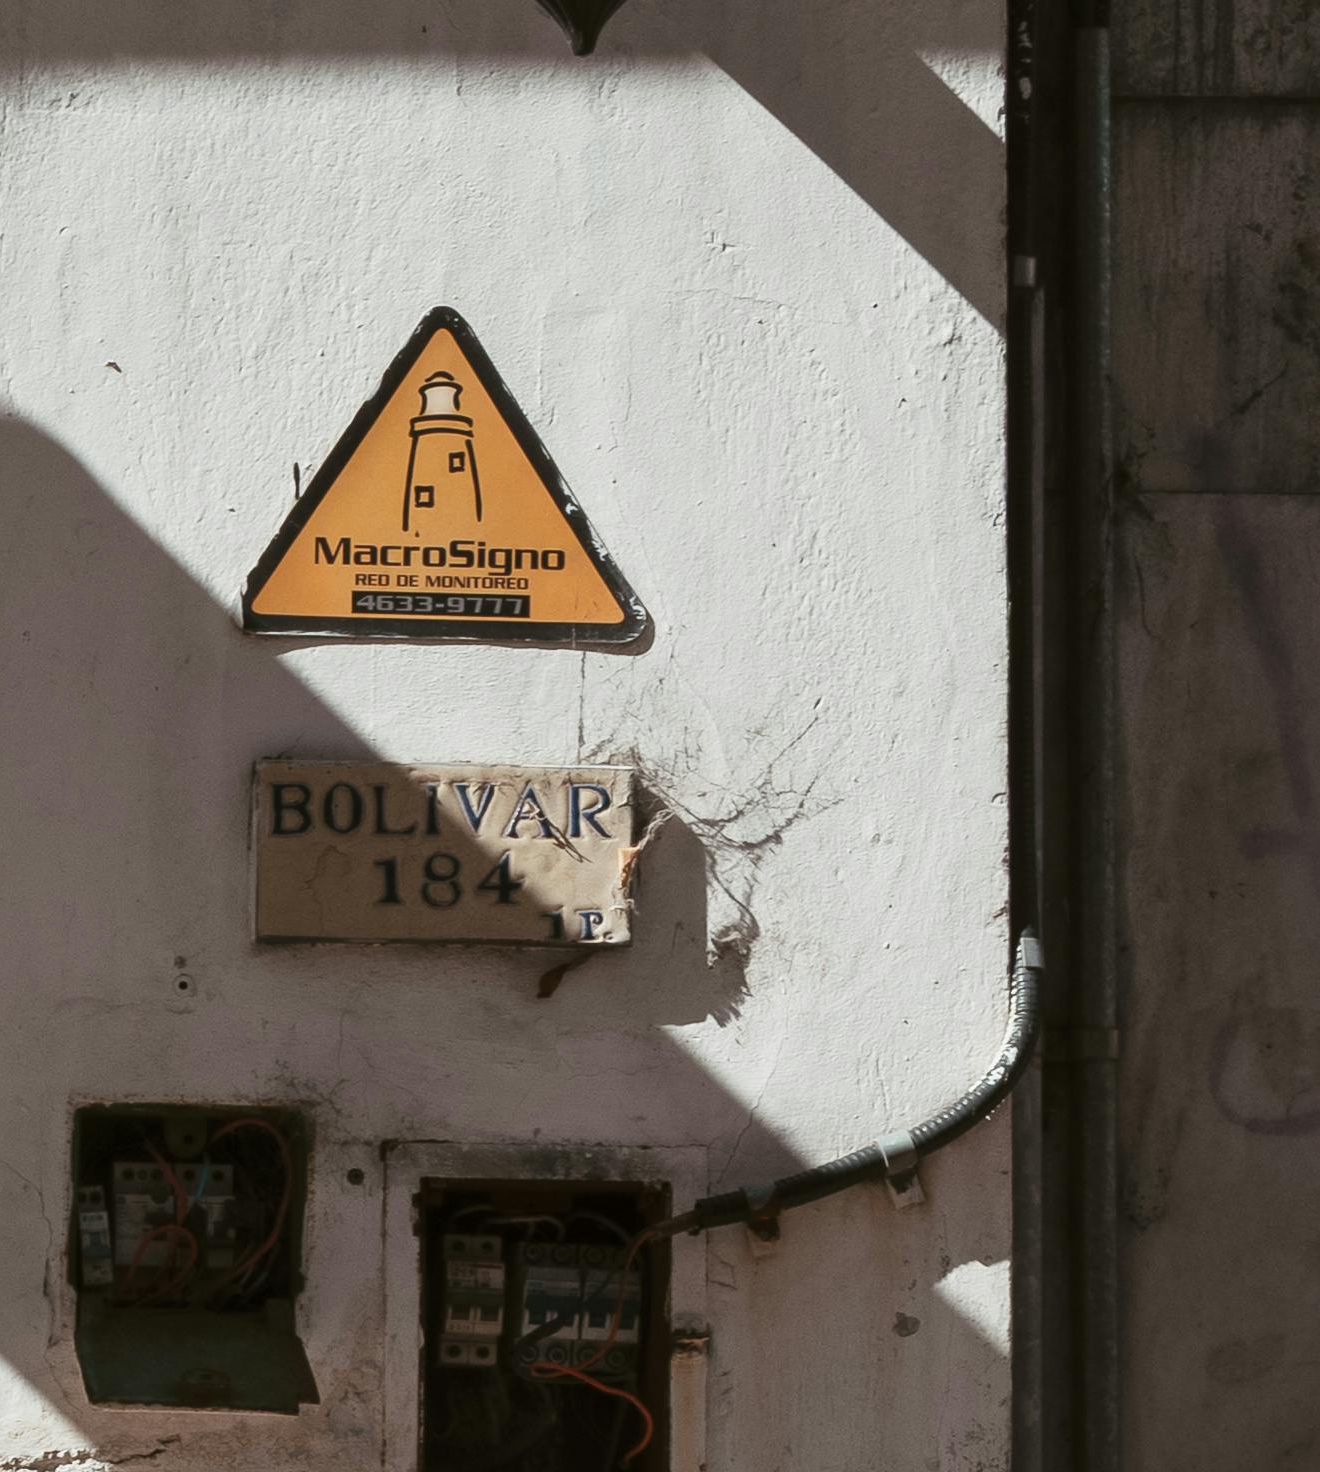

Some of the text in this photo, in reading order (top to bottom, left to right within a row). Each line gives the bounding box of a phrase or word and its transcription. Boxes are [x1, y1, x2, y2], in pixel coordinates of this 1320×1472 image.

[313, 536, 566, 576] MacroSigno
[355, 573, 529, 590] RED DE MONITOREO
[356, 592, 523, 615] 4633-9777
[270, 780, 614, 838] BOLIVAR
[374, 849, 525, 908] 184
